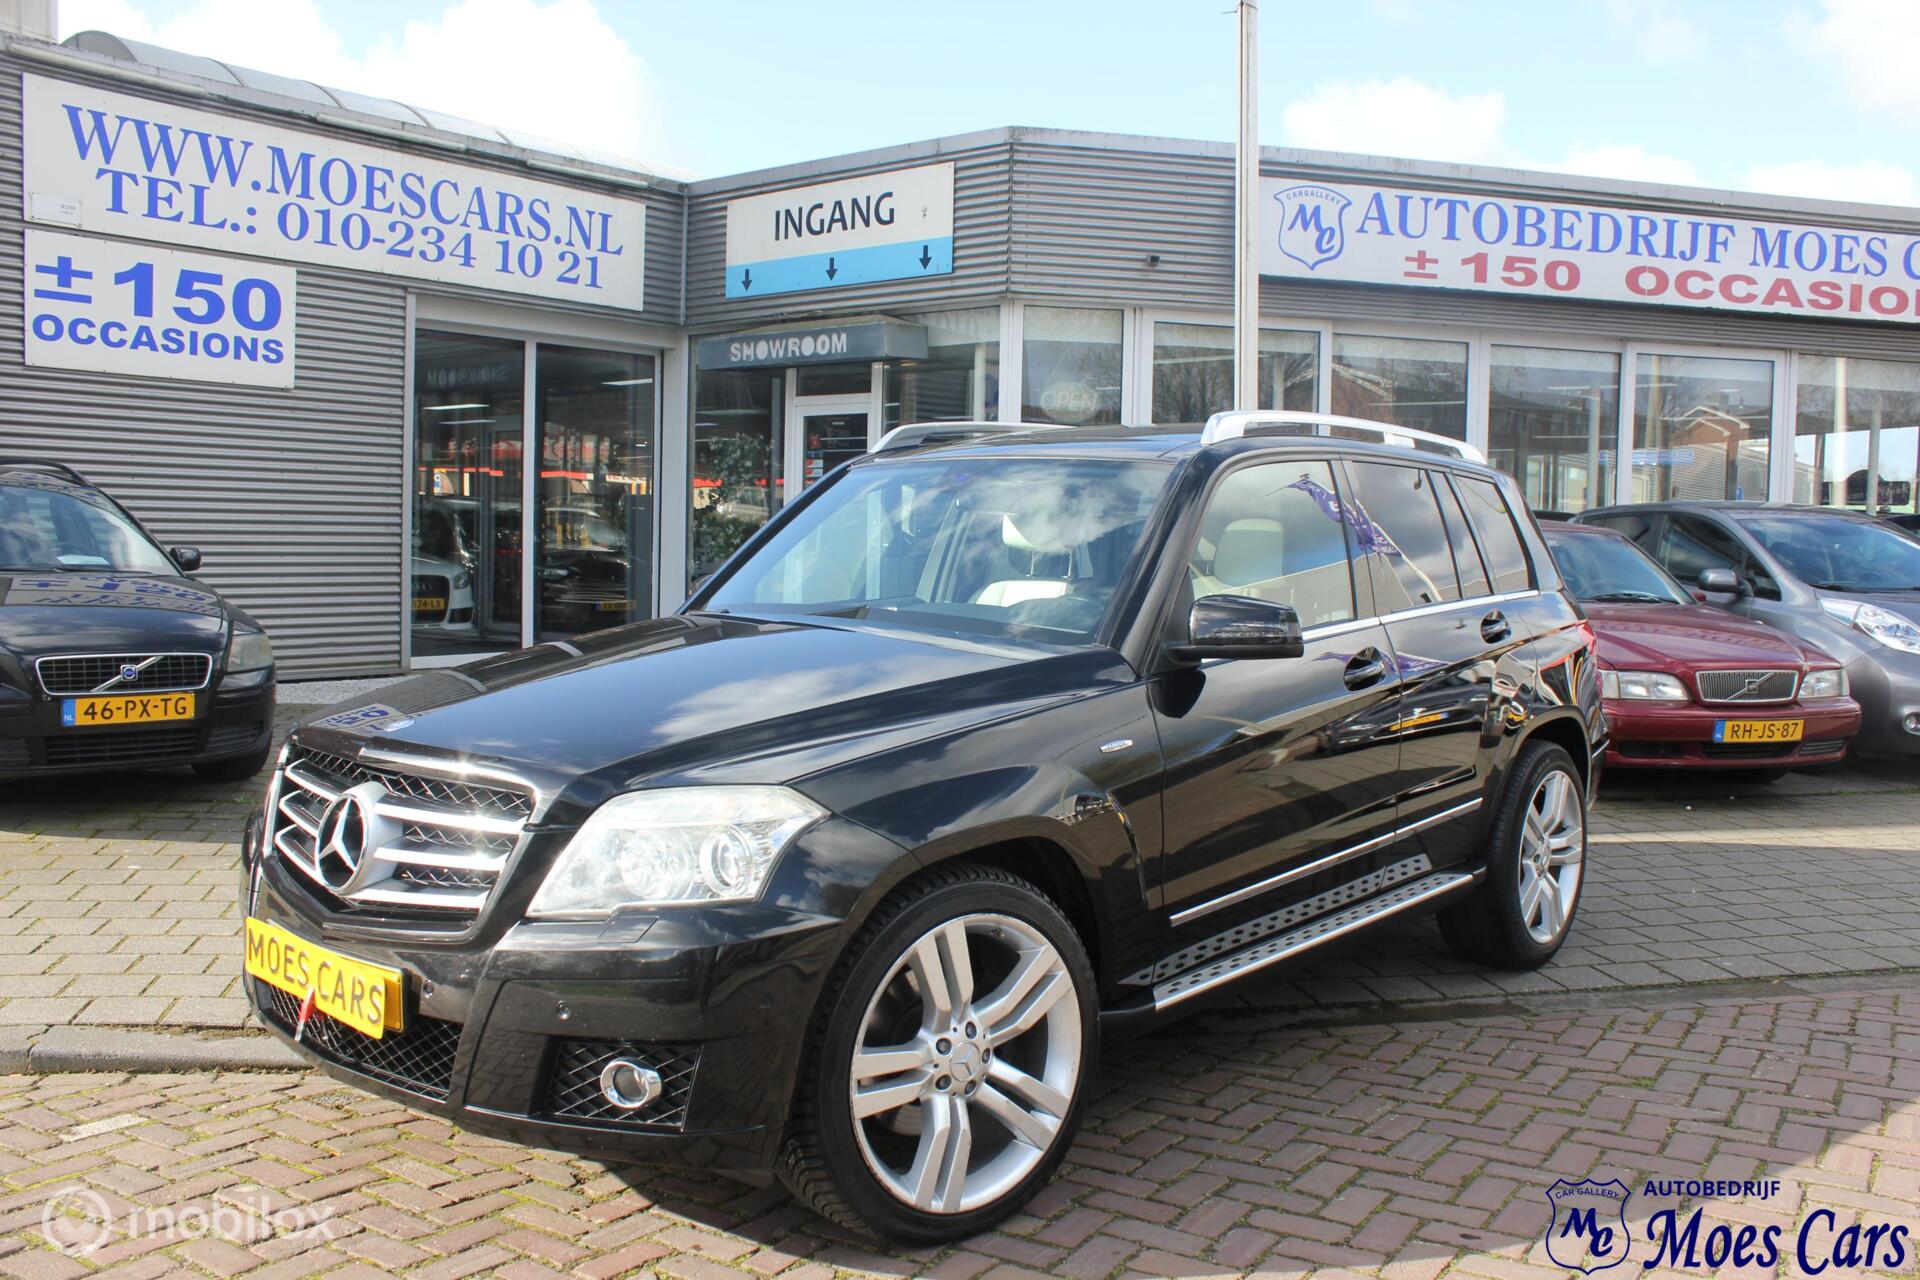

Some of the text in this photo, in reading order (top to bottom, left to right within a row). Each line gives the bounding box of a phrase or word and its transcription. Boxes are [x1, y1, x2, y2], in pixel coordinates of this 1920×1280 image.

[63, 104, 624, 256] WWW.MOESCARS.NL
[96, 168, 603, 289] TEL.: 010-234 10 21
[775, 191, 895, 241] INGANG
[1355, 190, 1736, 264] AUTOBEDRIJF
[1750, 226, 1889, 277] MOES
[113, 262, 283, 332] 150
[1460, 252, 1581, 292] 150
[1625, 266, 1920, 317] OCCASIO
[32, 313, 285, 364] OCCASIONS
[729, 332, 847, 362] SHOWROOM
[84, 697, 187, 720] 46-PX-TG
[1730, 722, 1799, 739] RH-JS-87
[248, 927, 383, 1035] MOES CARS
